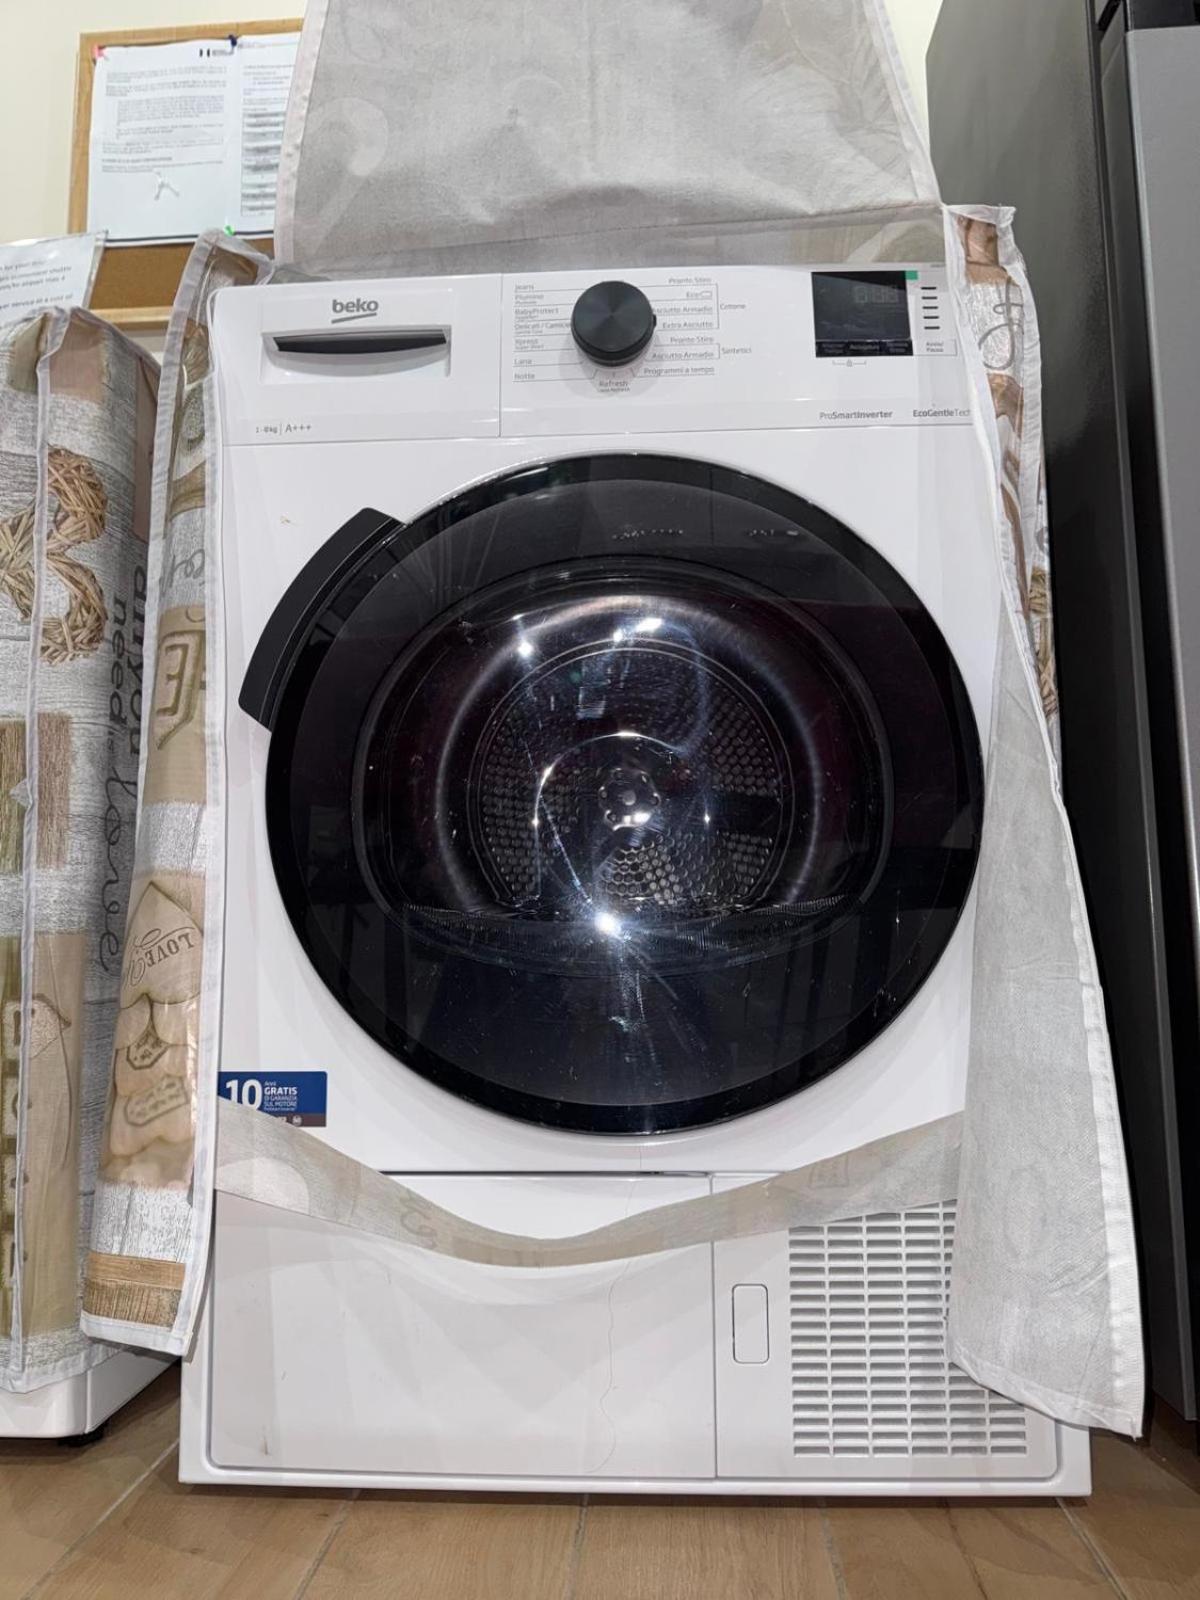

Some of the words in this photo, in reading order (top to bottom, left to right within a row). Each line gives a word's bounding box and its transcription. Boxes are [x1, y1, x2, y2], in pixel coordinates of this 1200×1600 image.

[332, 298, 379, 314] beko
[514, 308, 559, 316] BabyProtect
[643, 368, 684, 376] Programmi
[819, 410, 893, 420] ProSmartInverter
[145, 933, 194, 967] LOVE
[225, 1079, 262, 1109] 10
[264, 1087, 297, 1095] GRATIS
